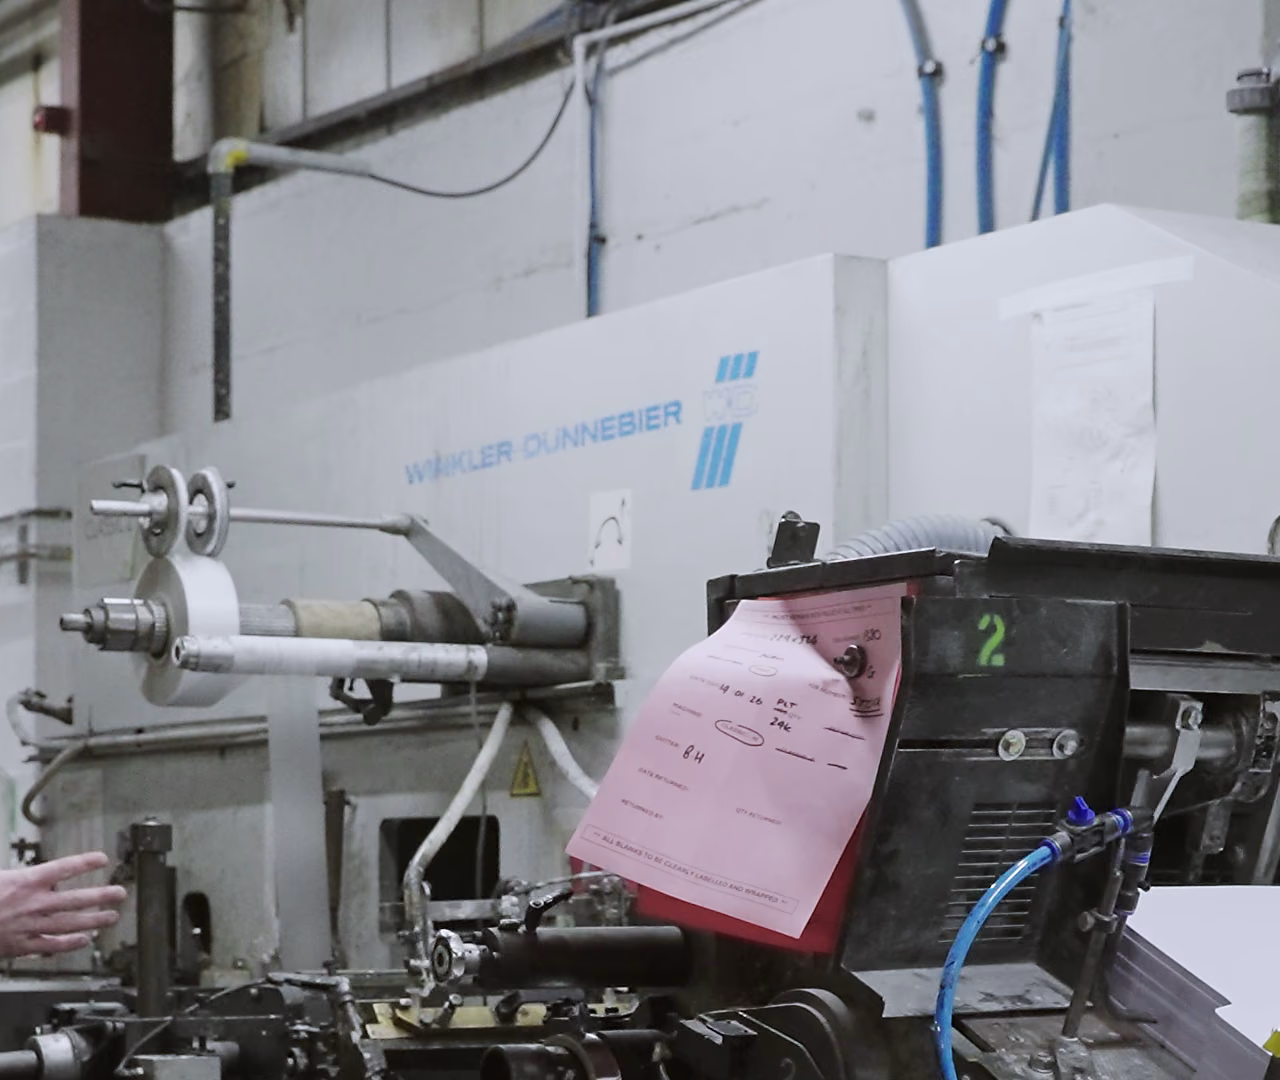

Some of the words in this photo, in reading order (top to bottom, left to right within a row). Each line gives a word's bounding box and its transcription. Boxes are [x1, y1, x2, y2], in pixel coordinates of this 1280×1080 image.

[405, 441, 513, 485] WINKLER
[976, 613, 1006, 667] 2
[602, 835, 614, 845] ALL
